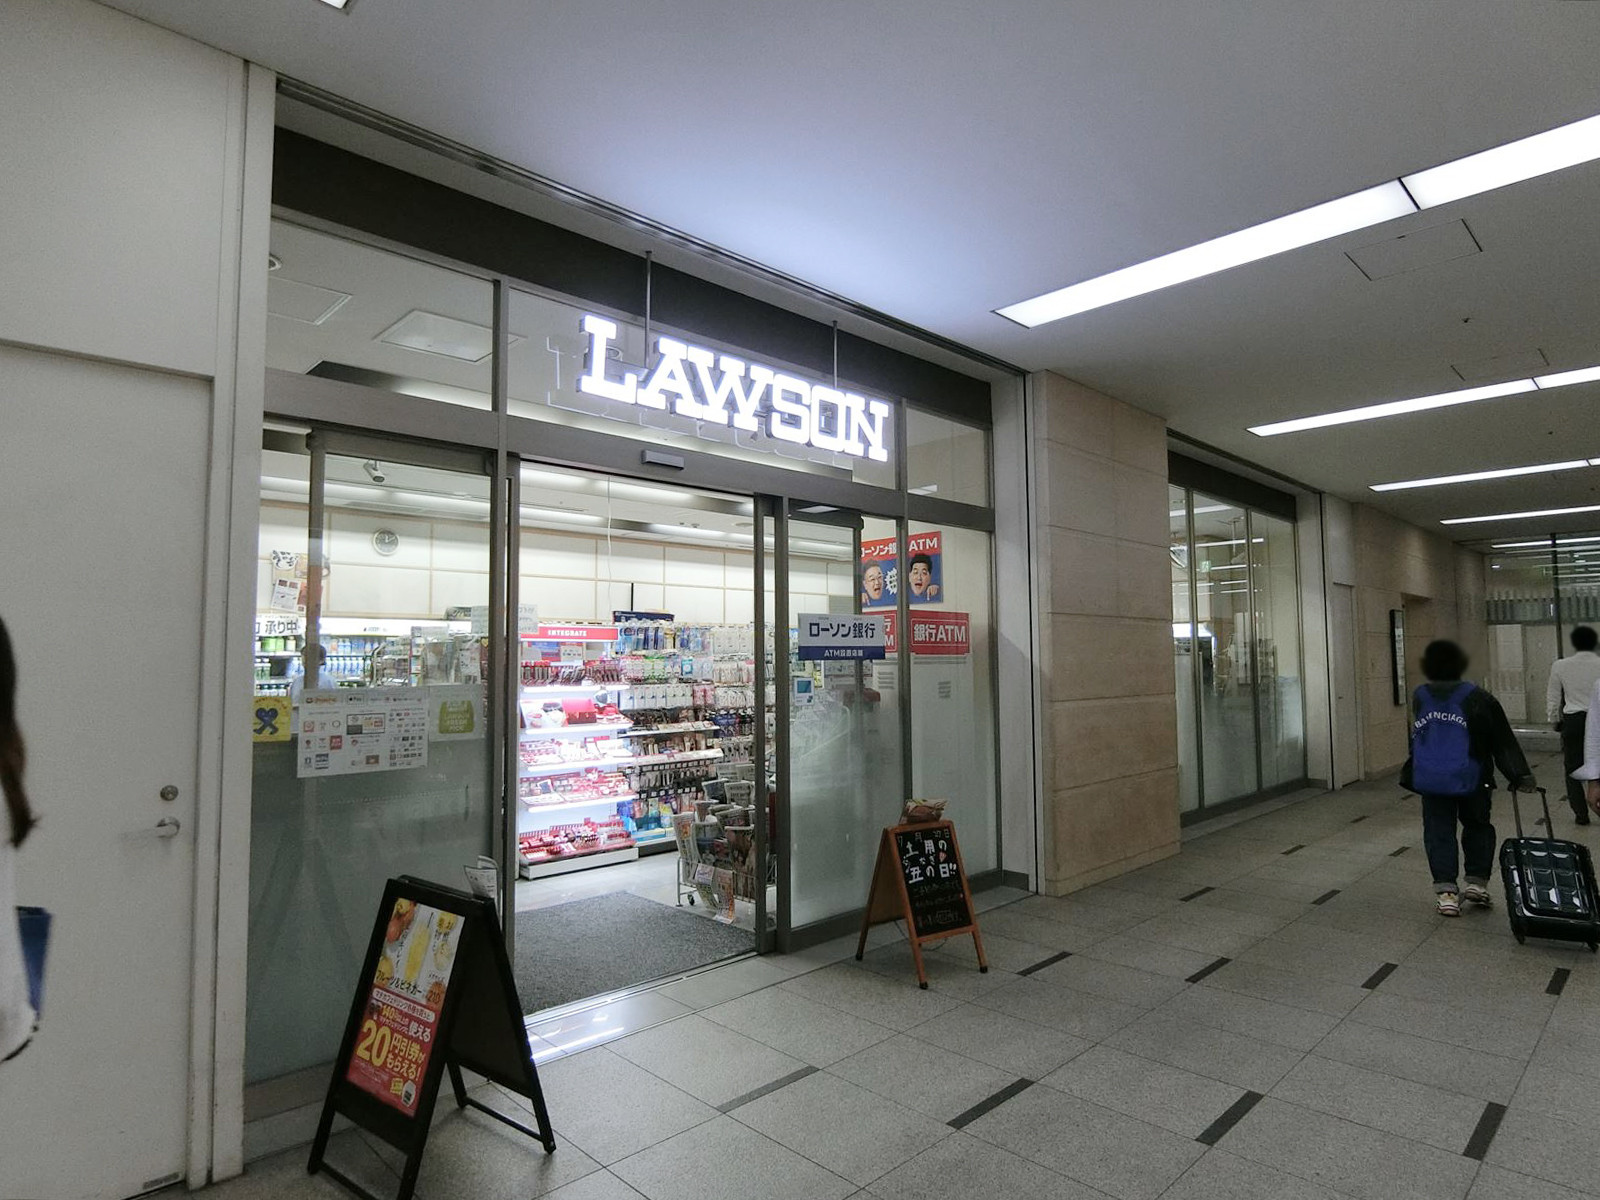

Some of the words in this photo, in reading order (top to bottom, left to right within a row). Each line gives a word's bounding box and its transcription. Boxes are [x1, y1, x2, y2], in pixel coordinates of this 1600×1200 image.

[579, 313, 889, 462] LAWSON
[908, 537, 938, 552] ATM
[547, 629, 587, 637] INTEGRATE
[808, 621, 876, 639] ローソン銀行
[913, 624, 966, 643] 銀行ATM
[905, 840, 947, 857] 土用の
[356, 1019, 392, 1067] 20
